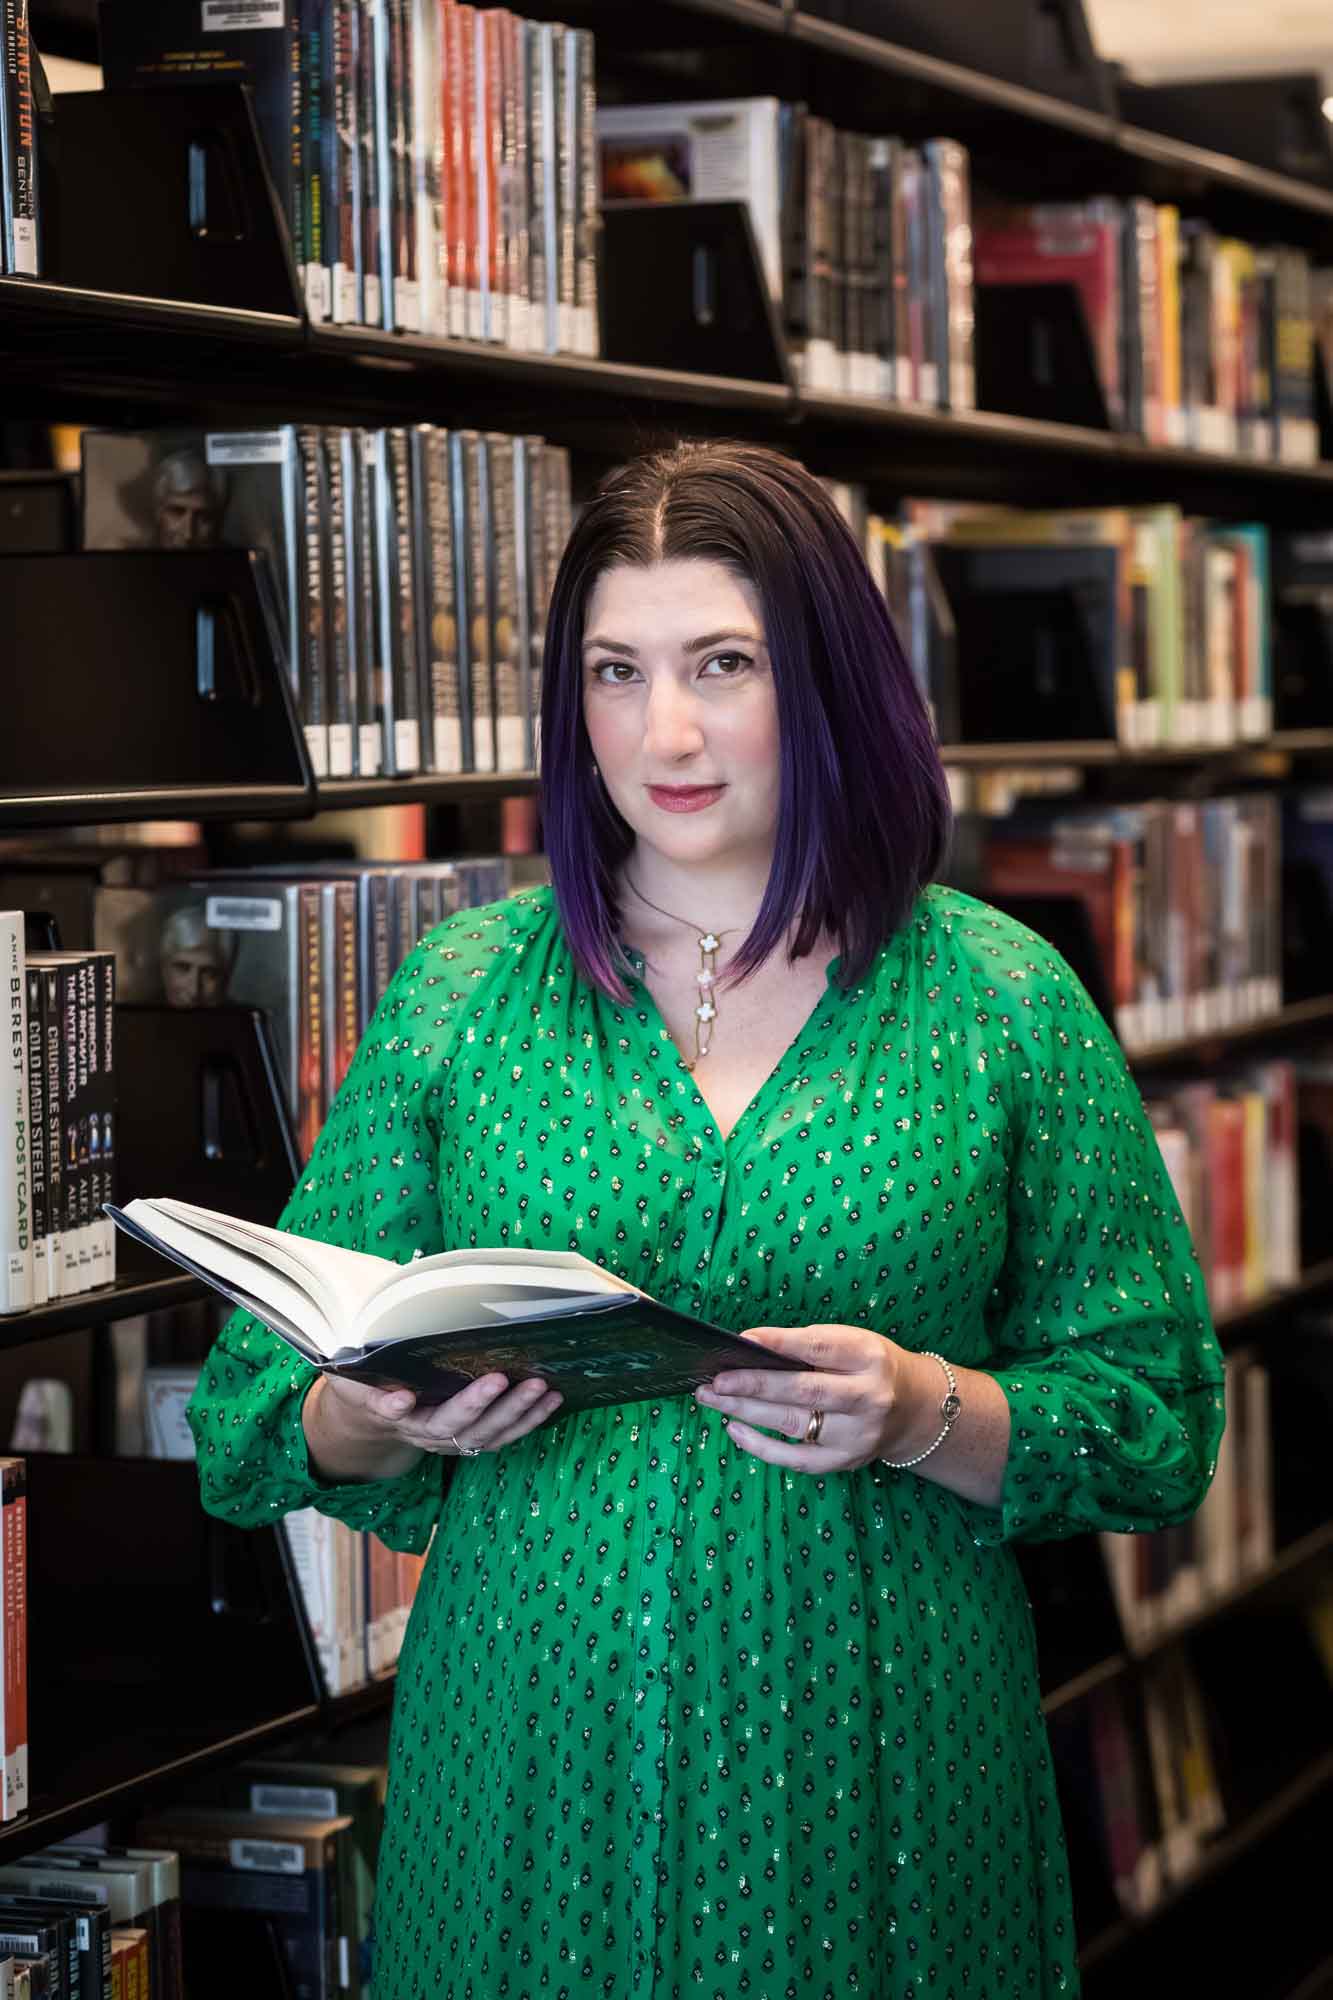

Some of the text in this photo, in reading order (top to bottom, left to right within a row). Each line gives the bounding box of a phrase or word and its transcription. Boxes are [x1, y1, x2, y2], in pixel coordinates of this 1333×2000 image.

[8, 31, 17, 74] THRILLER
[16, 17, 33, 147] SANCTION
[305, 461, 319, 526] STEVE
[330, 461, 343, 526] STEVE
[306, 533, 321, 600] BERRY
[332, 533, 346, 600] BERRY
[343, 919, 354, 982] STEVE
[79, 969, 87, 1007] NYTE
[87, 965, 98, 1073] NYTE TERRORS
[104, 964, 113, 1073] NYTE TERRORS
[308, 921, 321, 1057] STEVE BERRY
[10, 976, 23, 1074] BEREST
[67, 974, 77, 1102] THE NYTE PATROL
[29, 1020, 44, 1194] COLD HARD STEELE
[48, 1025, 60, 1185] CRUCIBLE STEELE
[15, 1120, 28, 1251] POSTCARD
[67, 1184, 77, 1221] ALEX
[80, 1178, 89, 1216] ALEX
[104, 1172, 113, 1203] ALE
